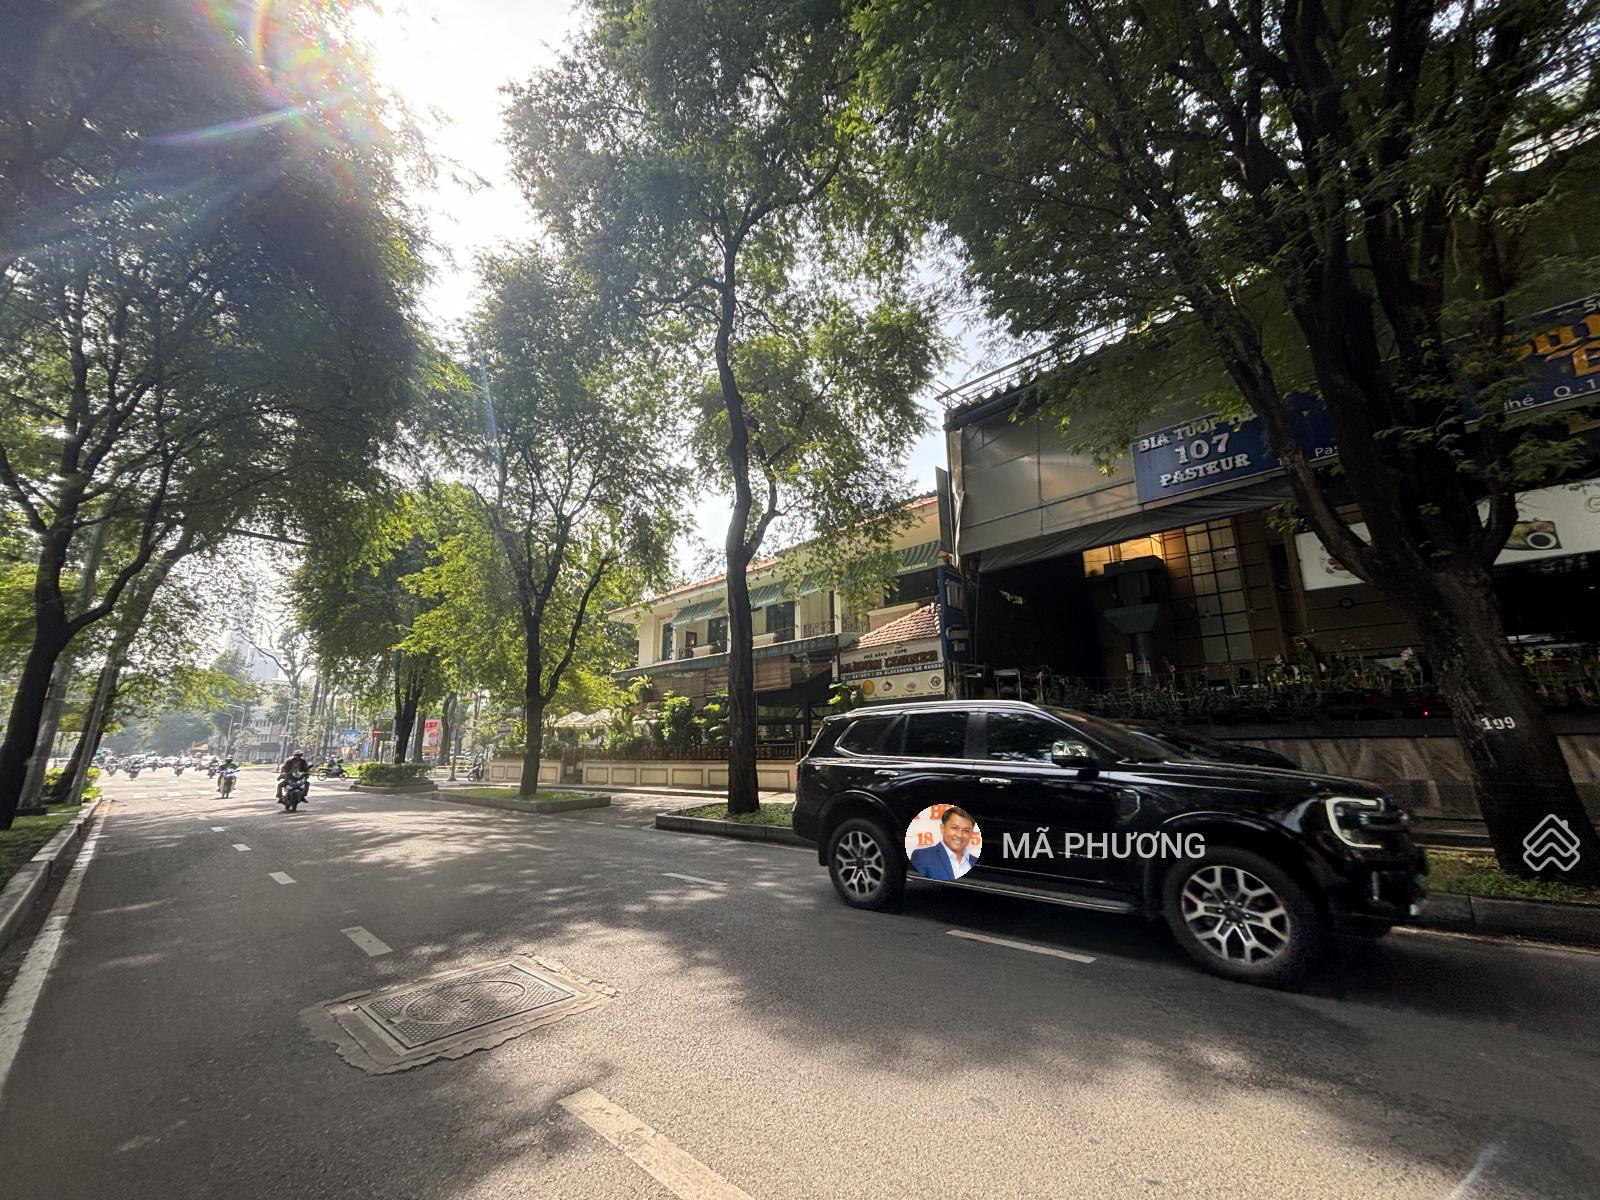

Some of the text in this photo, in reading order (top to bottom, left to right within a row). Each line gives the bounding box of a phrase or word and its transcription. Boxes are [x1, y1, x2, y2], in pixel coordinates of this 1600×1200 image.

[1138, 435, 1171, 453] BIA
[1174, 431, 1230, 465] 107
[1159, 453, 1252, 488] PASTEUR
